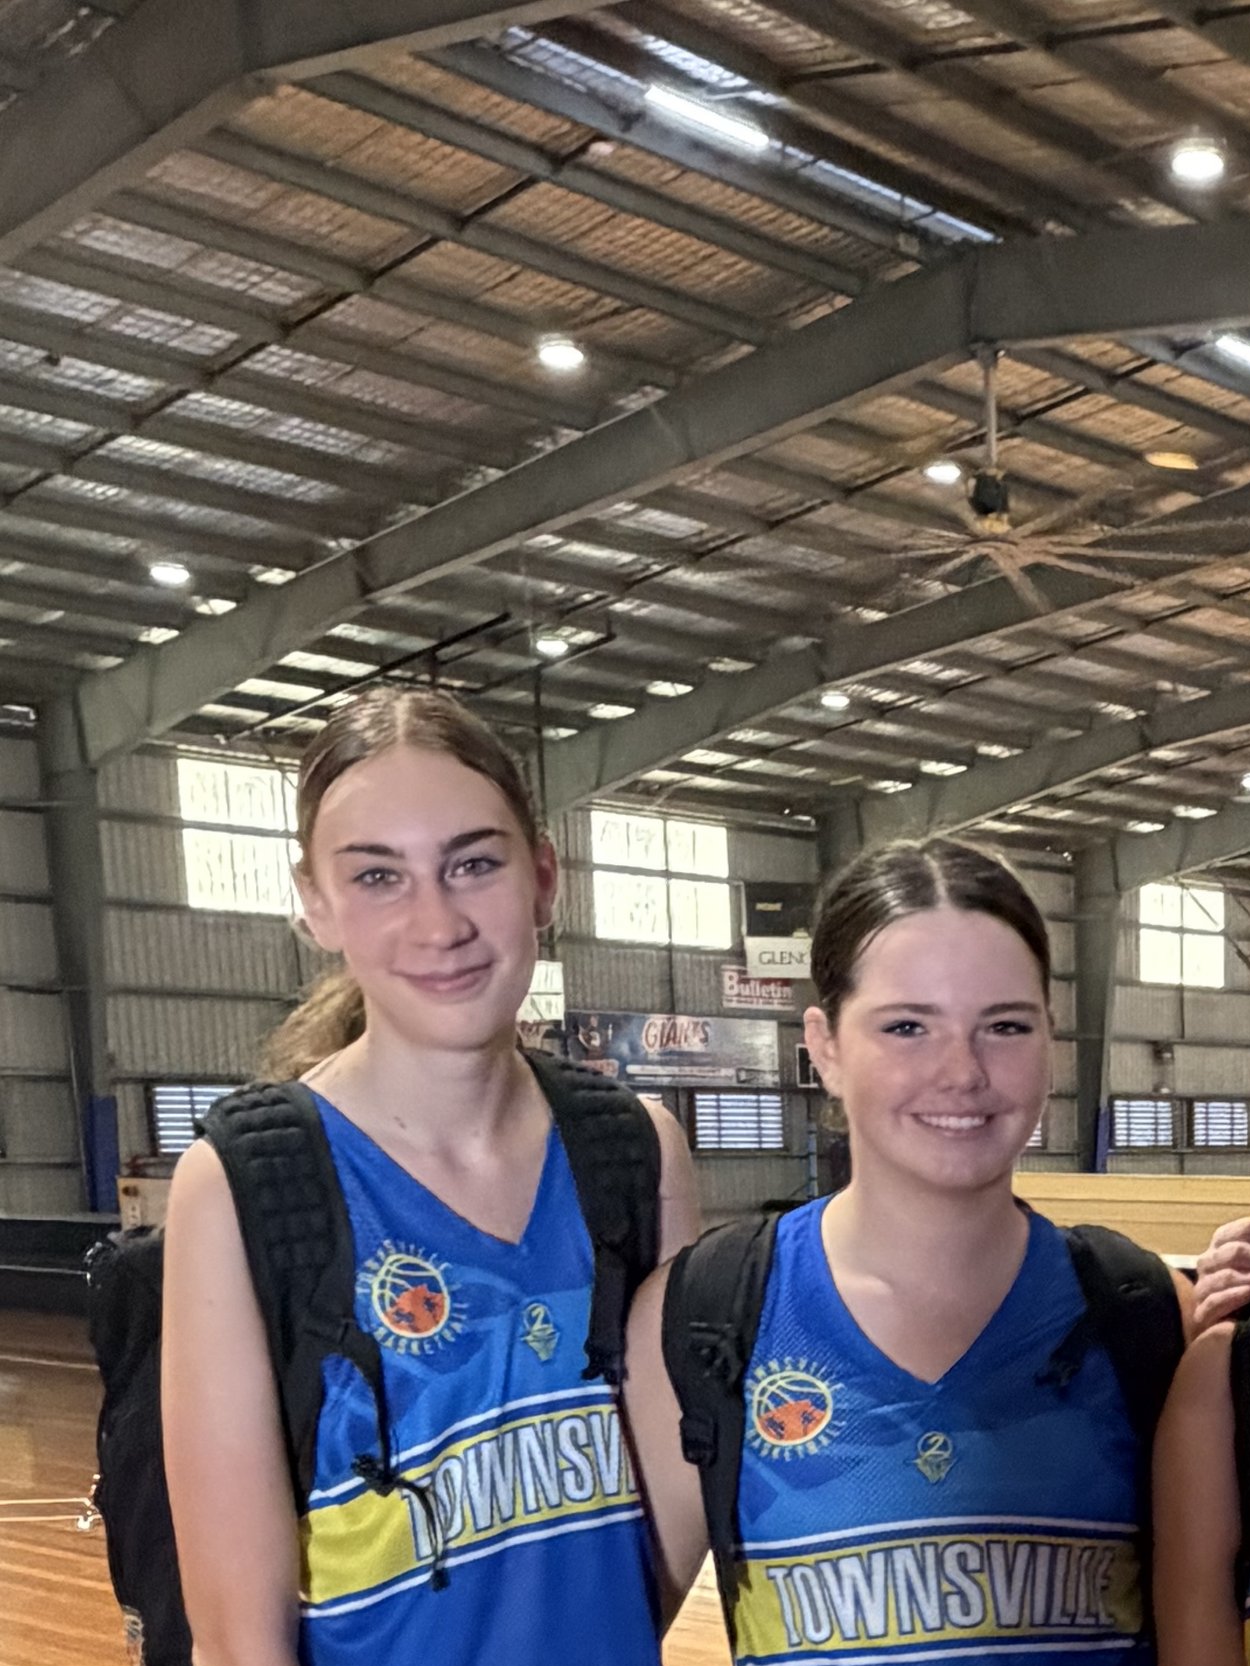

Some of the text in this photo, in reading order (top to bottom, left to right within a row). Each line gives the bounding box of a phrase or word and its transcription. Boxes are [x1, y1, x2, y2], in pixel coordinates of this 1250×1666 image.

[723, 970, 793, 999] Bulletin
[402, 1410, 640, 1562] TOWNSV
[766, 1539, 1116, 1648] TOWNSVILLE
